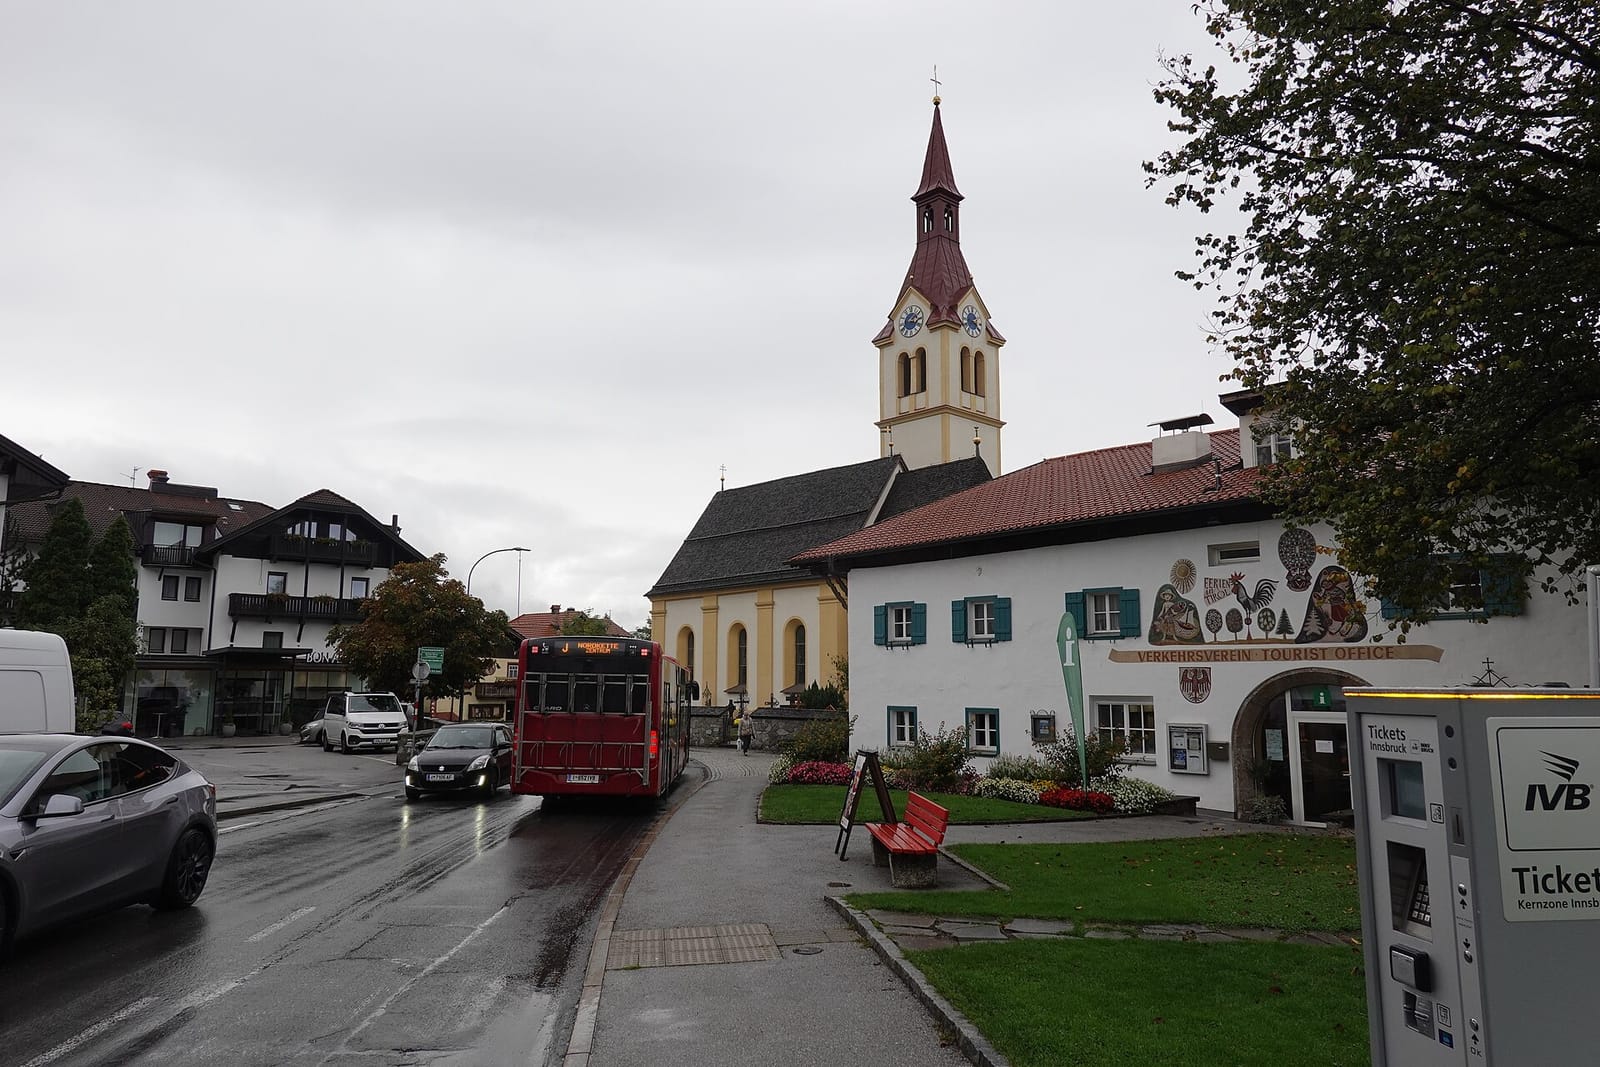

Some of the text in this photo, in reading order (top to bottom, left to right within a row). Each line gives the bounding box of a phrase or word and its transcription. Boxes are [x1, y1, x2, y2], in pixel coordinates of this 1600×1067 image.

[1203, 577, 1230, 589] FERIEN
[1204, 589, 1230, 605] TIROL
[561, 642, 619, 653] J NORDKETTE
[1137, 645, 1394, 663] VERKEHRSVEREIN TOURIST OFFICE
[306, 651, 329, 663] BON
[1368, 725, 1406, 741] Tickets
[1370, 741, 1407, 754] Innsbruck
[1525, 784, 1591, 811] IVB
[1511, 865, 1600, 895] Ticket
[1518, 900, 1568, 910] Kernzone
